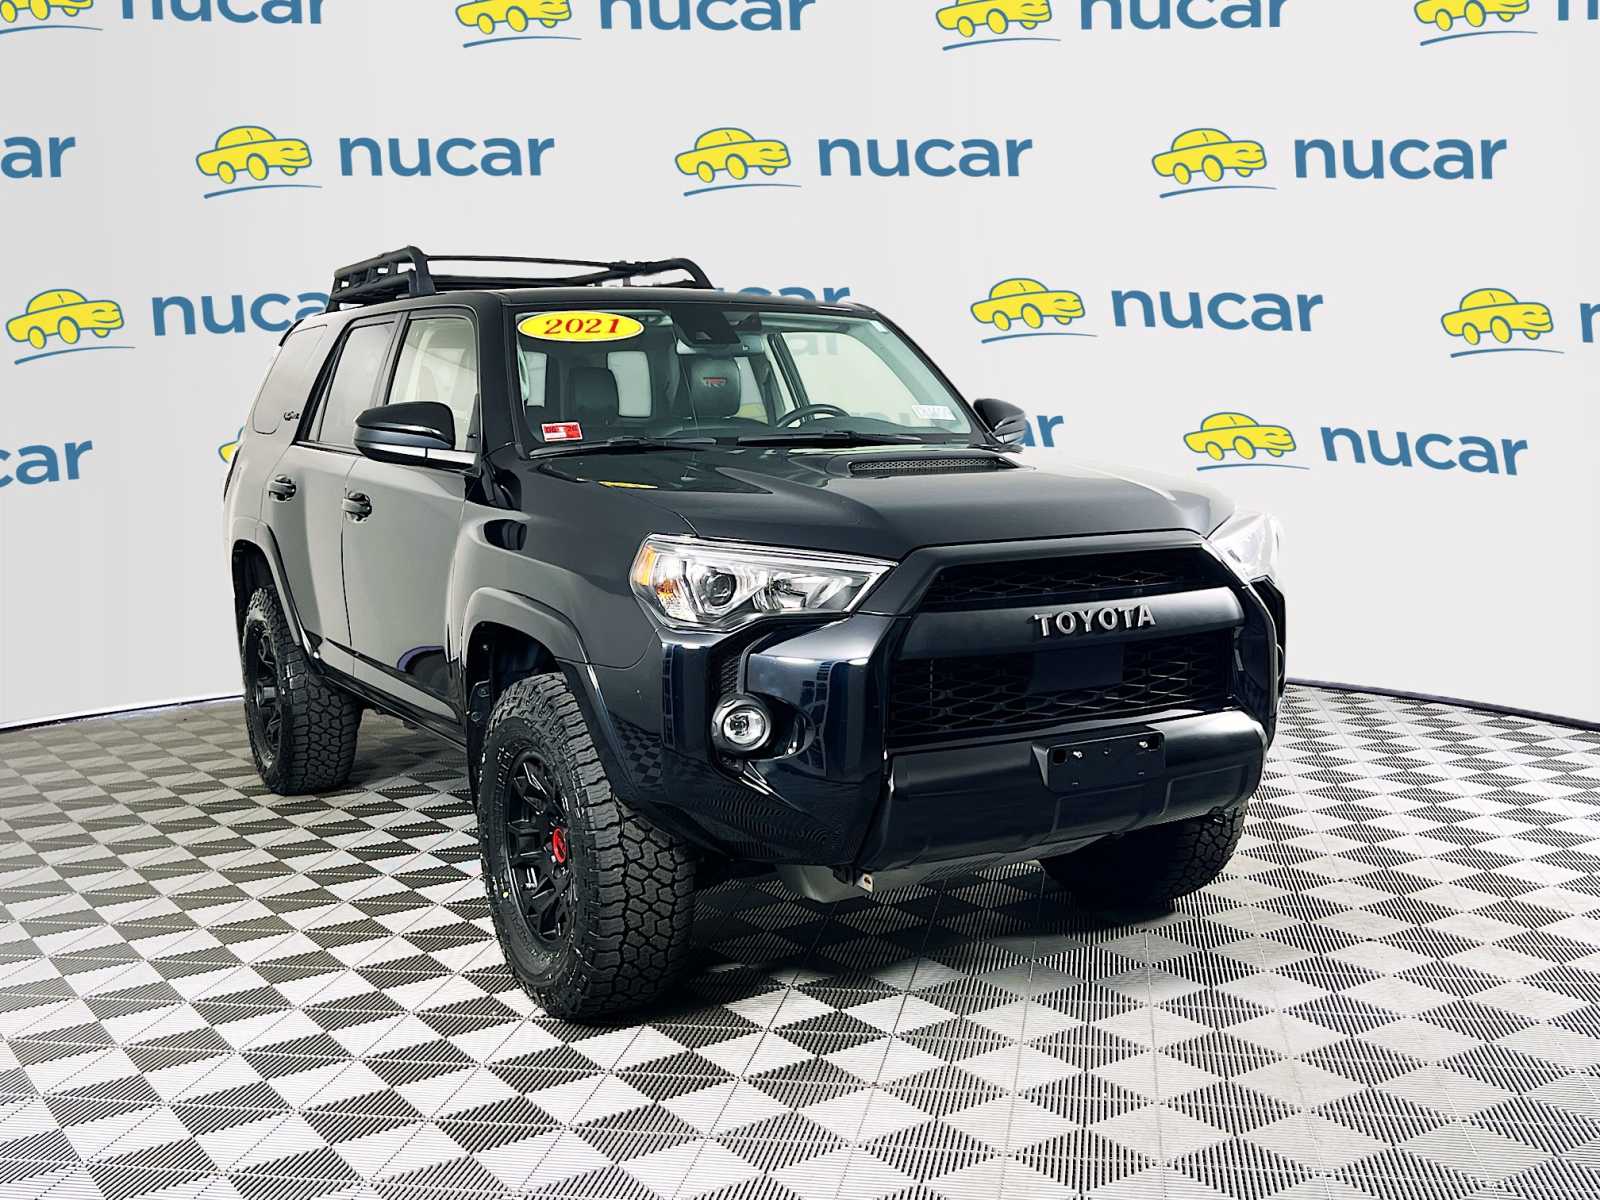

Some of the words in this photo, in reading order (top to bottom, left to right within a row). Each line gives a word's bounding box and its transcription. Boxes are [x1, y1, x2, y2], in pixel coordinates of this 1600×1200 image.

[599, 0, 817, 33] nucar
[1080, 0, 1287, 32] nucar
[338, 136, 556, 178] nucar
[817, 137, 1034, 178] nucar
[1294, 137, 1508, 182] nucar
[543, 318, 620, 335] 2021
[1111, 289, 1325, 333] nucar
[1319, 425, 1529, 477] nucar
[1033, 604, 1157, 638] TOYOTA
